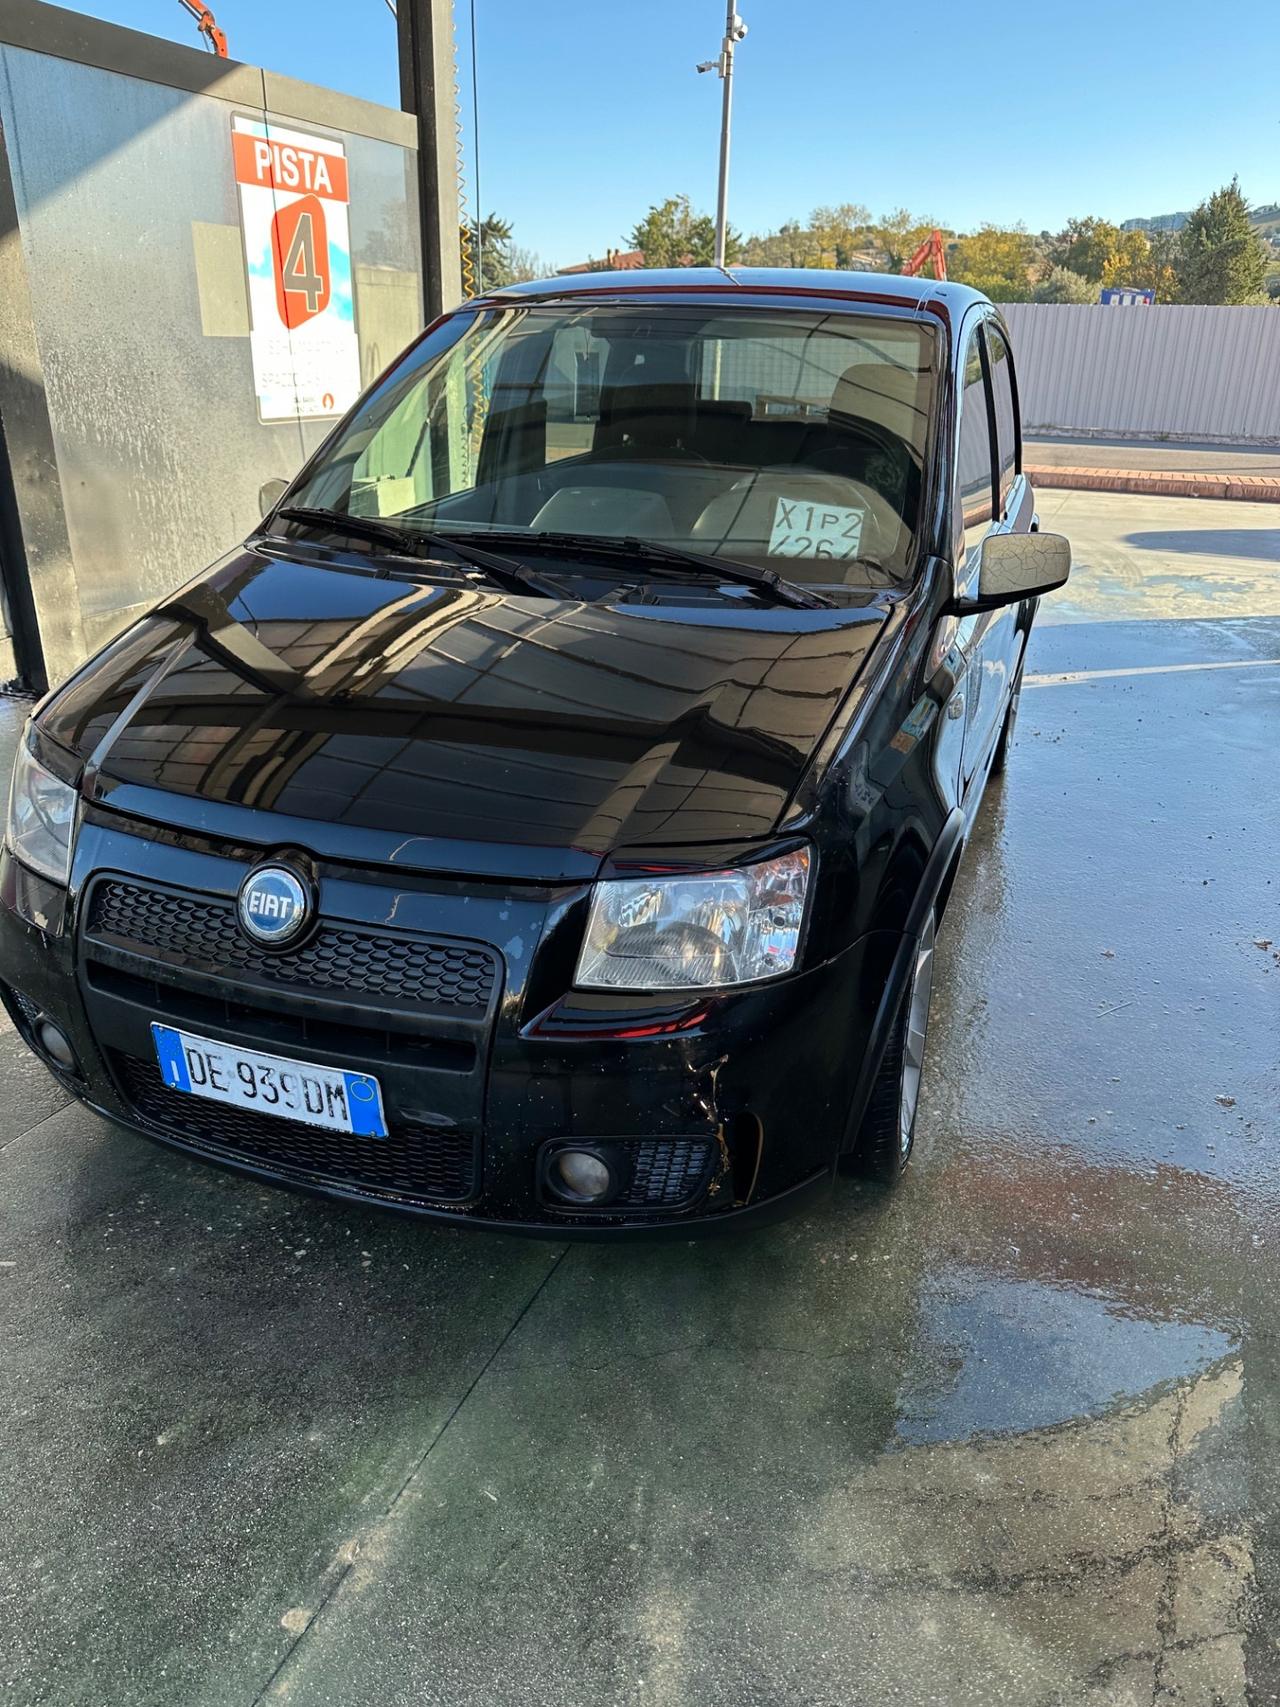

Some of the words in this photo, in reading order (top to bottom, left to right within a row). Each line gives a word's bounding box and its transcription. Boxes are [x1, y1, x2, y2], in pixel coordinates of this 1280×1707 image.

[253, 140, 333, 194] PISTA
[283, 212, 324, 313] 4
[248, 891, 292, 919] FIAT
